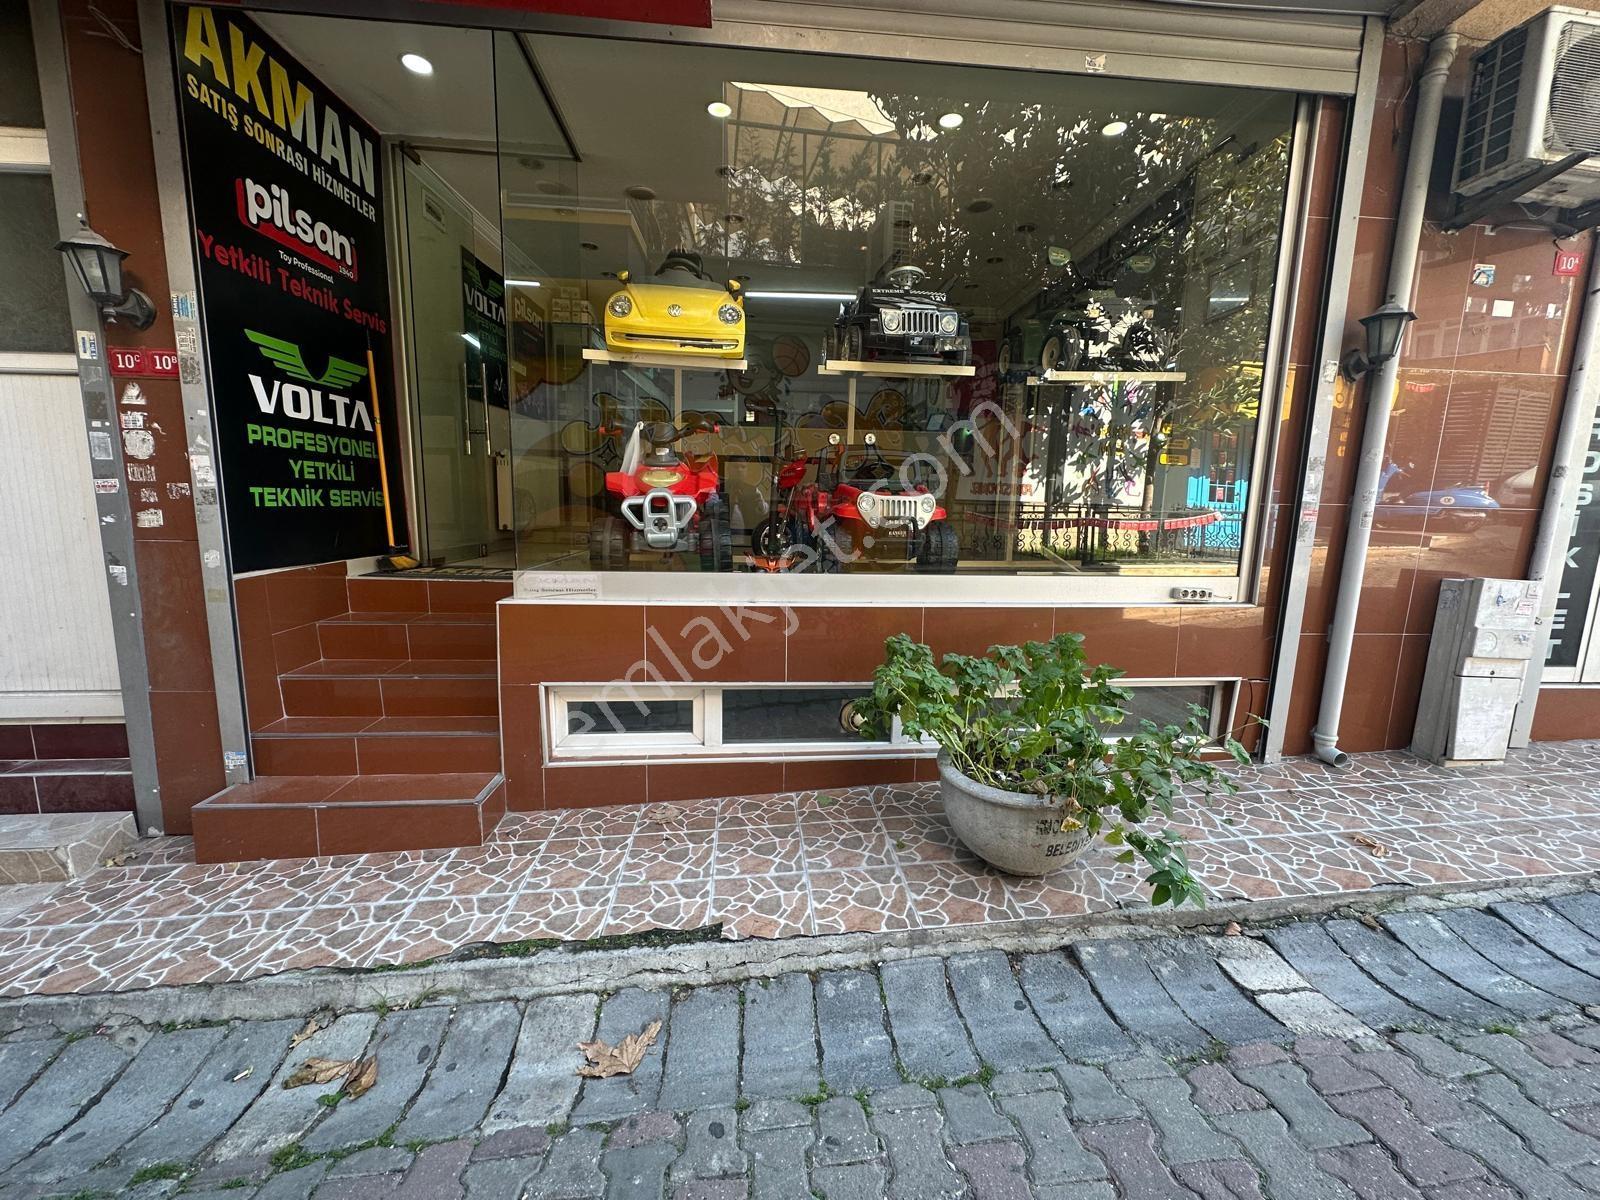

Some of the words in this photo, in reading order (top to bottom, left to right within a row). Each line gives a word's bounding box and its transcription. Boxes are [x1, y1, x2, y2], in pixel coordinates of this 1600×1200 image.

[184, 6, 375, 198] AKMAN
[186, 73, 239, 132] SATIŞ
[243, 114, 309, 177] SONRASI
[312, 164, 376, 223] HİZMETLER
[245, 177, 352, 266] pilsan
[198, 229, 272, 285] Yetkili
[277, 267, 339, 314] Teknik
[343, 298, 387, 335] Servis
[279, 250, 292, 265] Toy
[293, 259, 334, 284] Professional
[464, 282, 506, 326] VOLTA
[514, 296, 544, 331] pilsan
[248, 373, 374, 432] VOLTA
[247, 423, 378, 459] PROFESYONEL
[289, 458, 356, 482] YETKİLİ
[250, 484, 325, 508] TEKNİK
[329, 487, 386, 508] SERVİS
